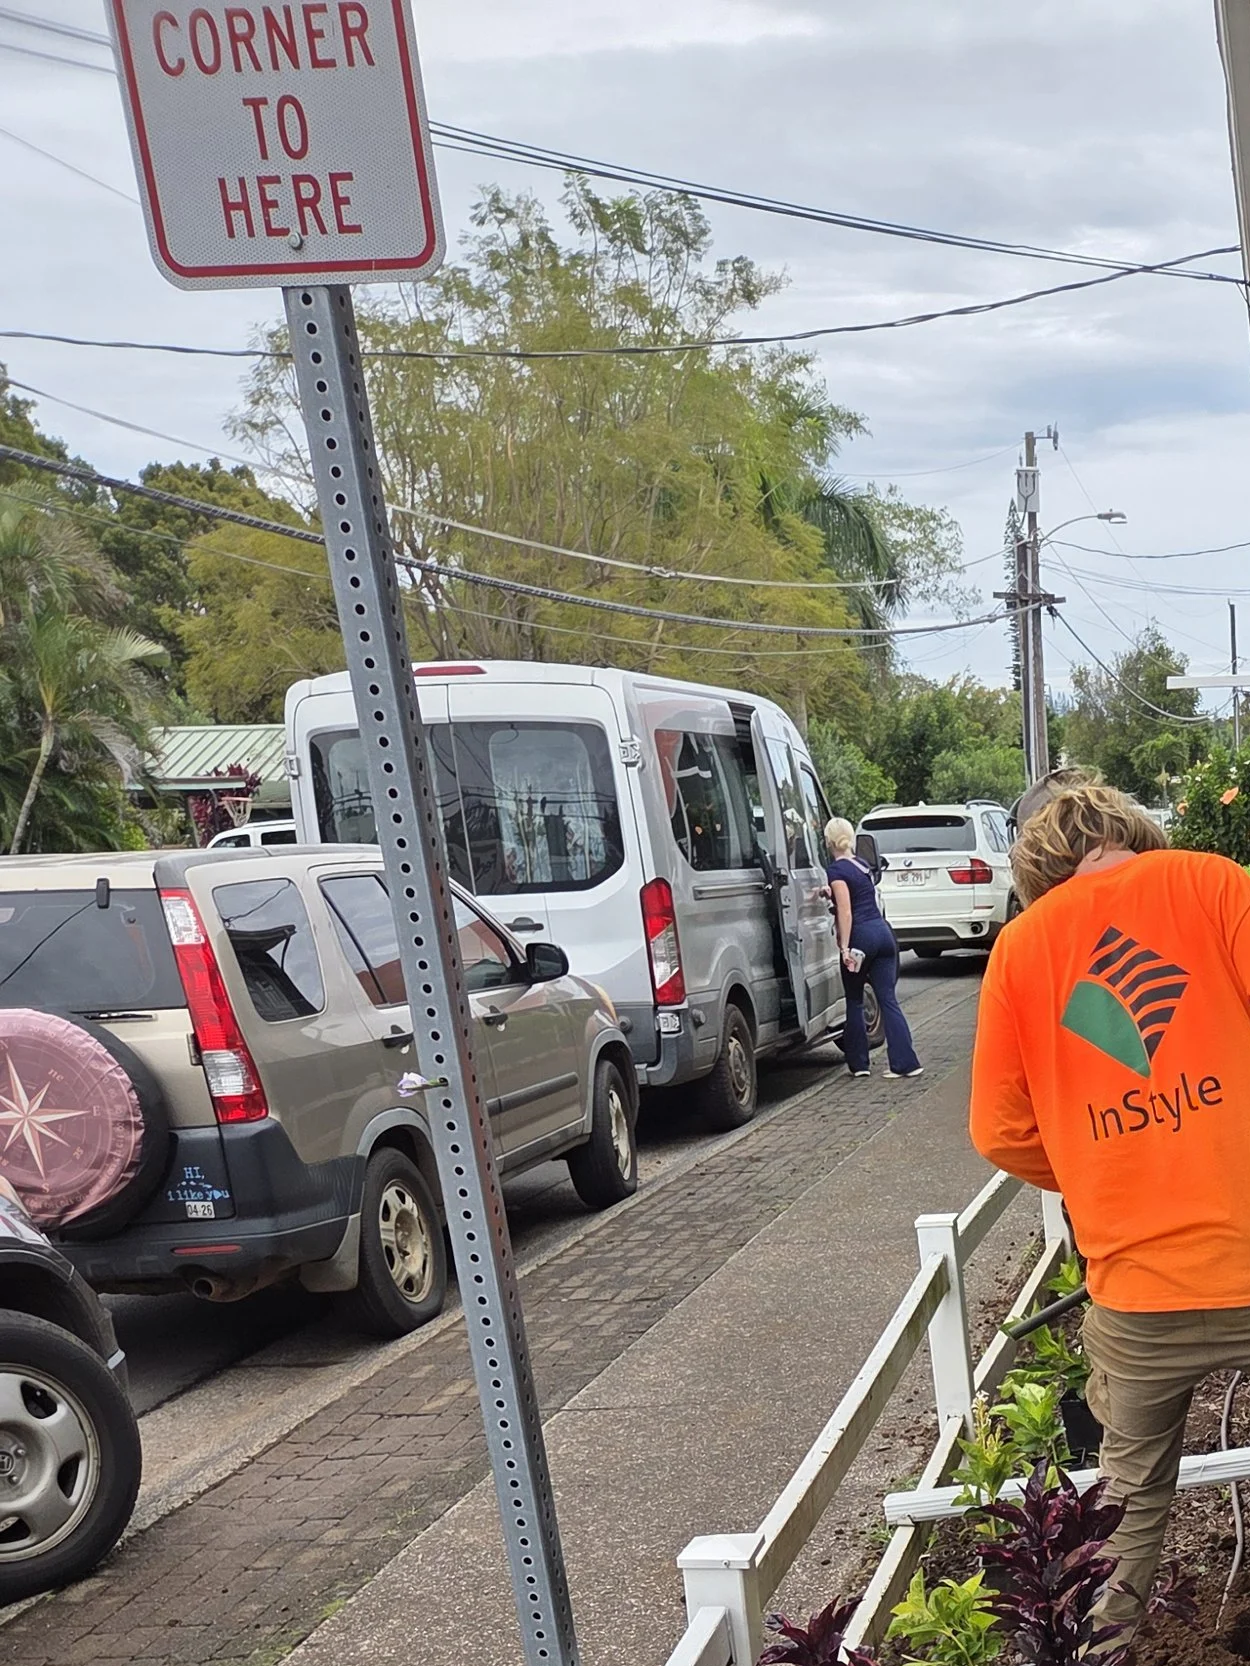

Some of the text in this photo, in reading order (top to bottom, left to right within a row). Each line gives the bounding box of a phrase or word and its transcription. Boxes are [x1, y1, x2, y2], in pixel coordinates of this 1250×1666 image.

[152, 2, 376, 77] CORNER
[242, 94, 309, 161] TO
[217, 171, 363, 239] HERE
[1087, 1072, 1223, 1141] InStyle
[176, 1189, 204, 1201] like
